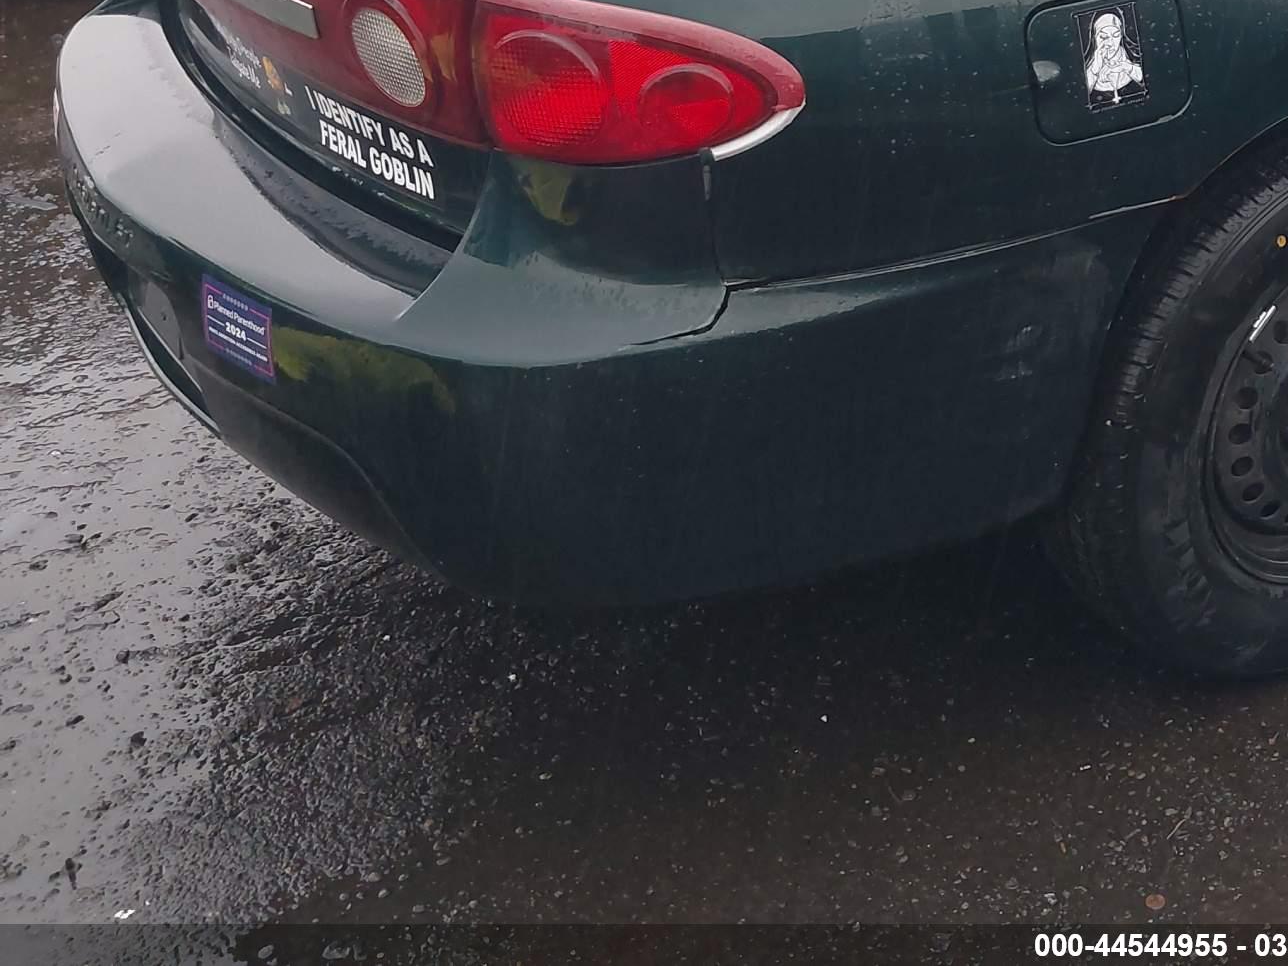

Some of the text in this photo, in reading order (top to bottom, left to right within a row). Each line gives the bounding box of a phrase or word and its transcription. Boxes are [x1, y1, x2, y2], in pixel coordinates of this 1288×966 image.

[304, 85, 434, 168] I IDENTIFY AS A
[319, 119, 435, 200] FERAL GOBLIN
[225, 321, 247, 342] 2024
